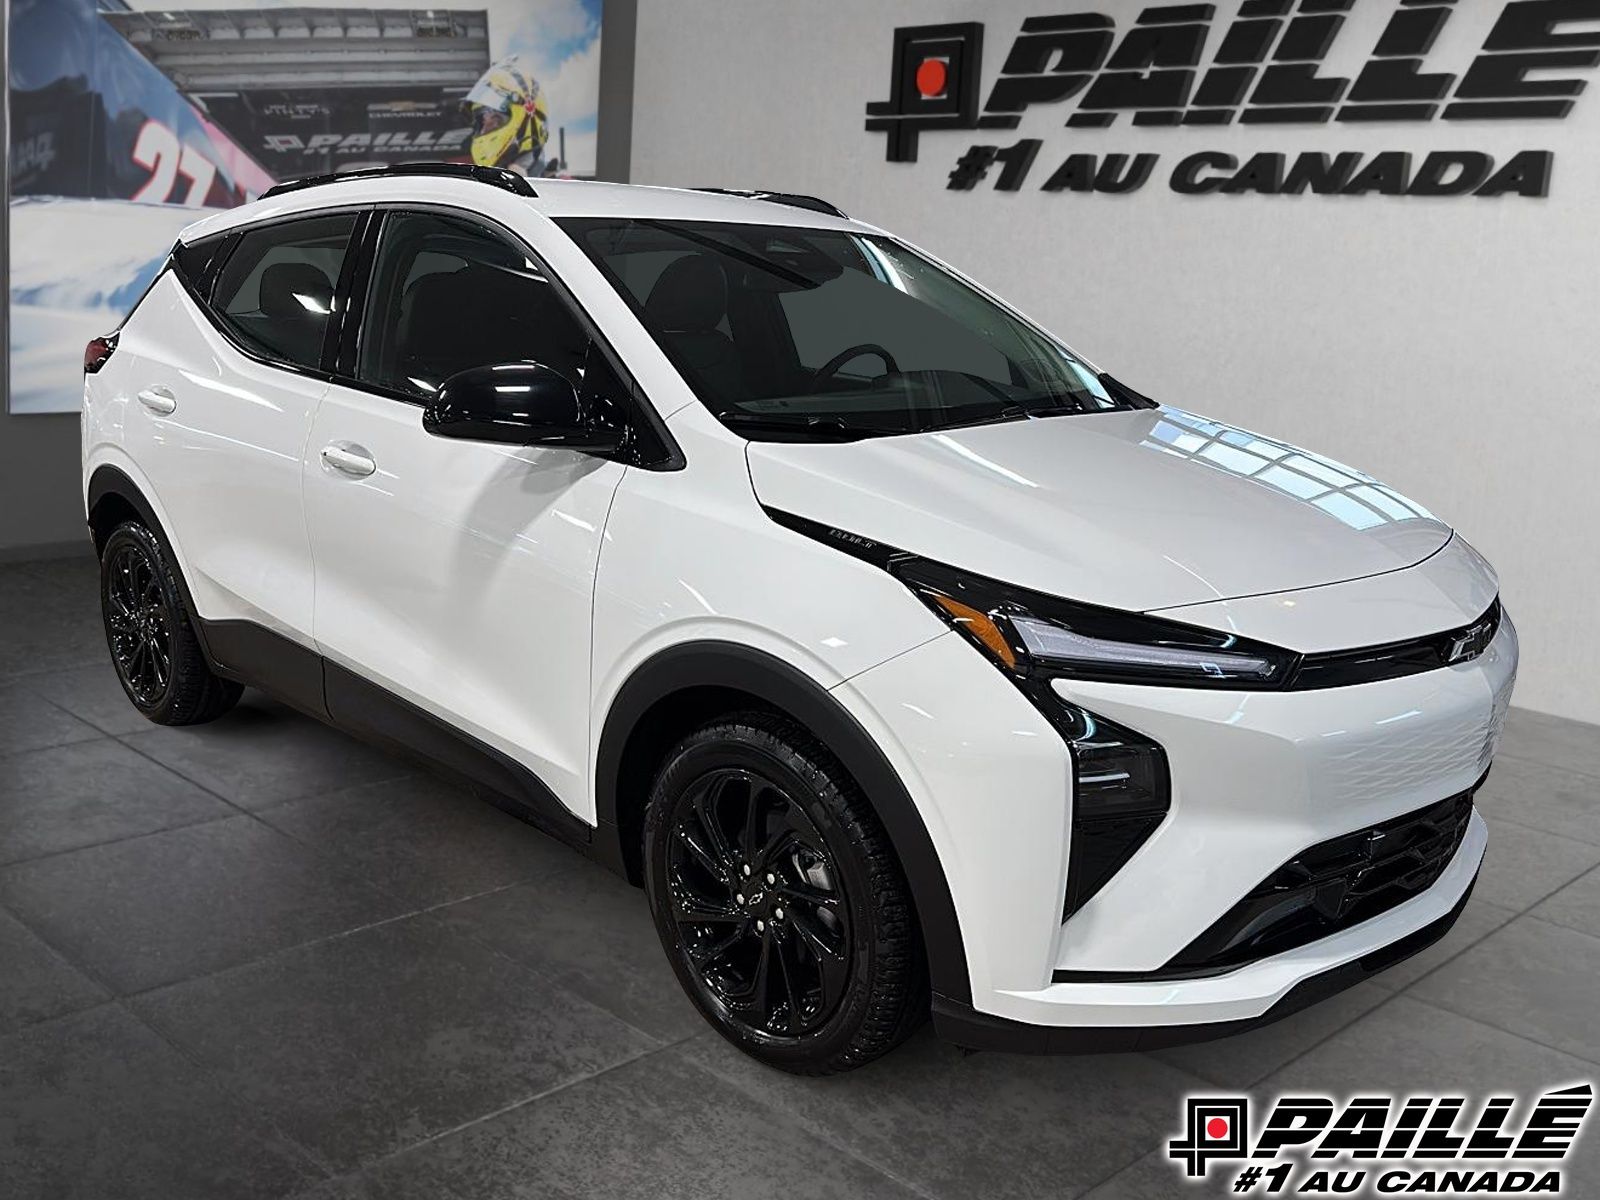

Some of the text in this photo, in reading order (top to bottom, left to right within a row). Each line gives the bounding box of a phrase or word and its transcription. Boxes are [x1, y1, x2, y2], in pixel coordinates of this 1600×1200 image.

[130, 118, 216, 207] 27
[336, 145, 365, 154] AU
[373, 144, 463, 153] CANADA
[946, 139, 1555, 198] #1 AU CANADA
